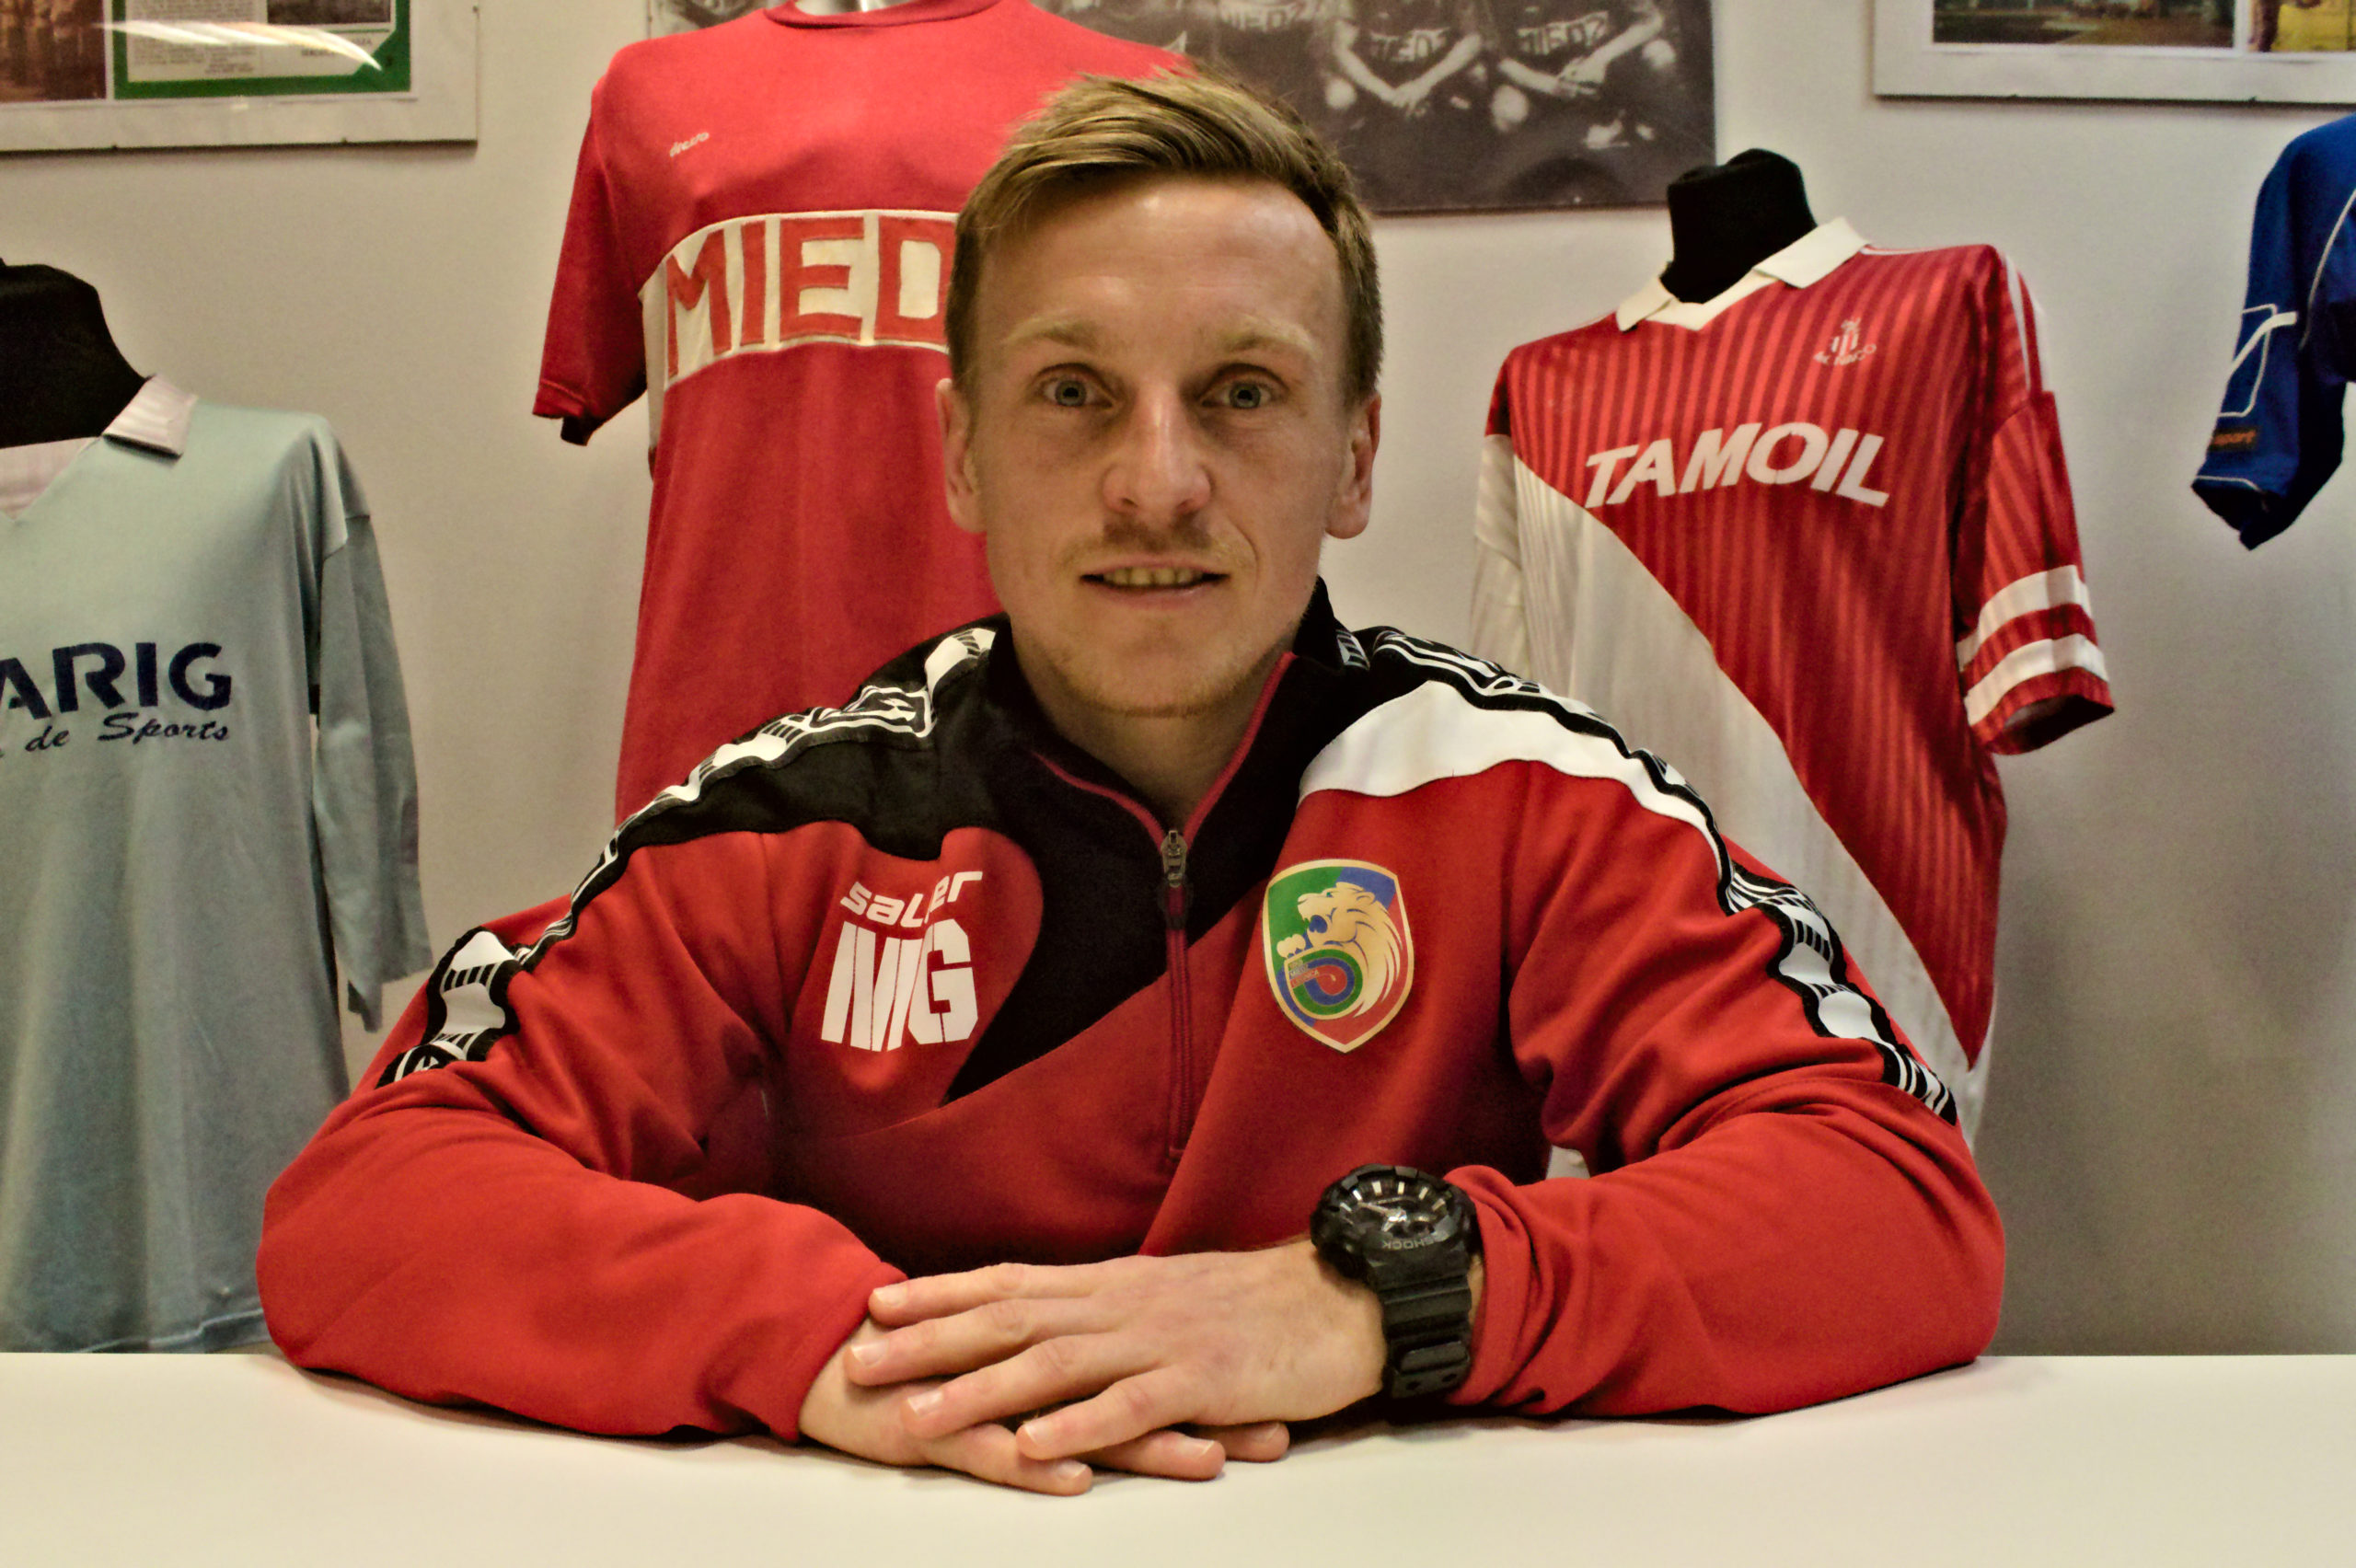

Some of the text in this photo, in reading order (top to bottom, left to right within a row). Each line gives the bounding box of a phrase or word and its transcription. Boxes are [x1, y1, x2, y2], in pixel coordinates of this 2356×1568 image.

[665, 215, 957, 379] MIED
[1585, 421, 1890, 509] TAMOIL
[24, 712, 229, 752] de Sports
